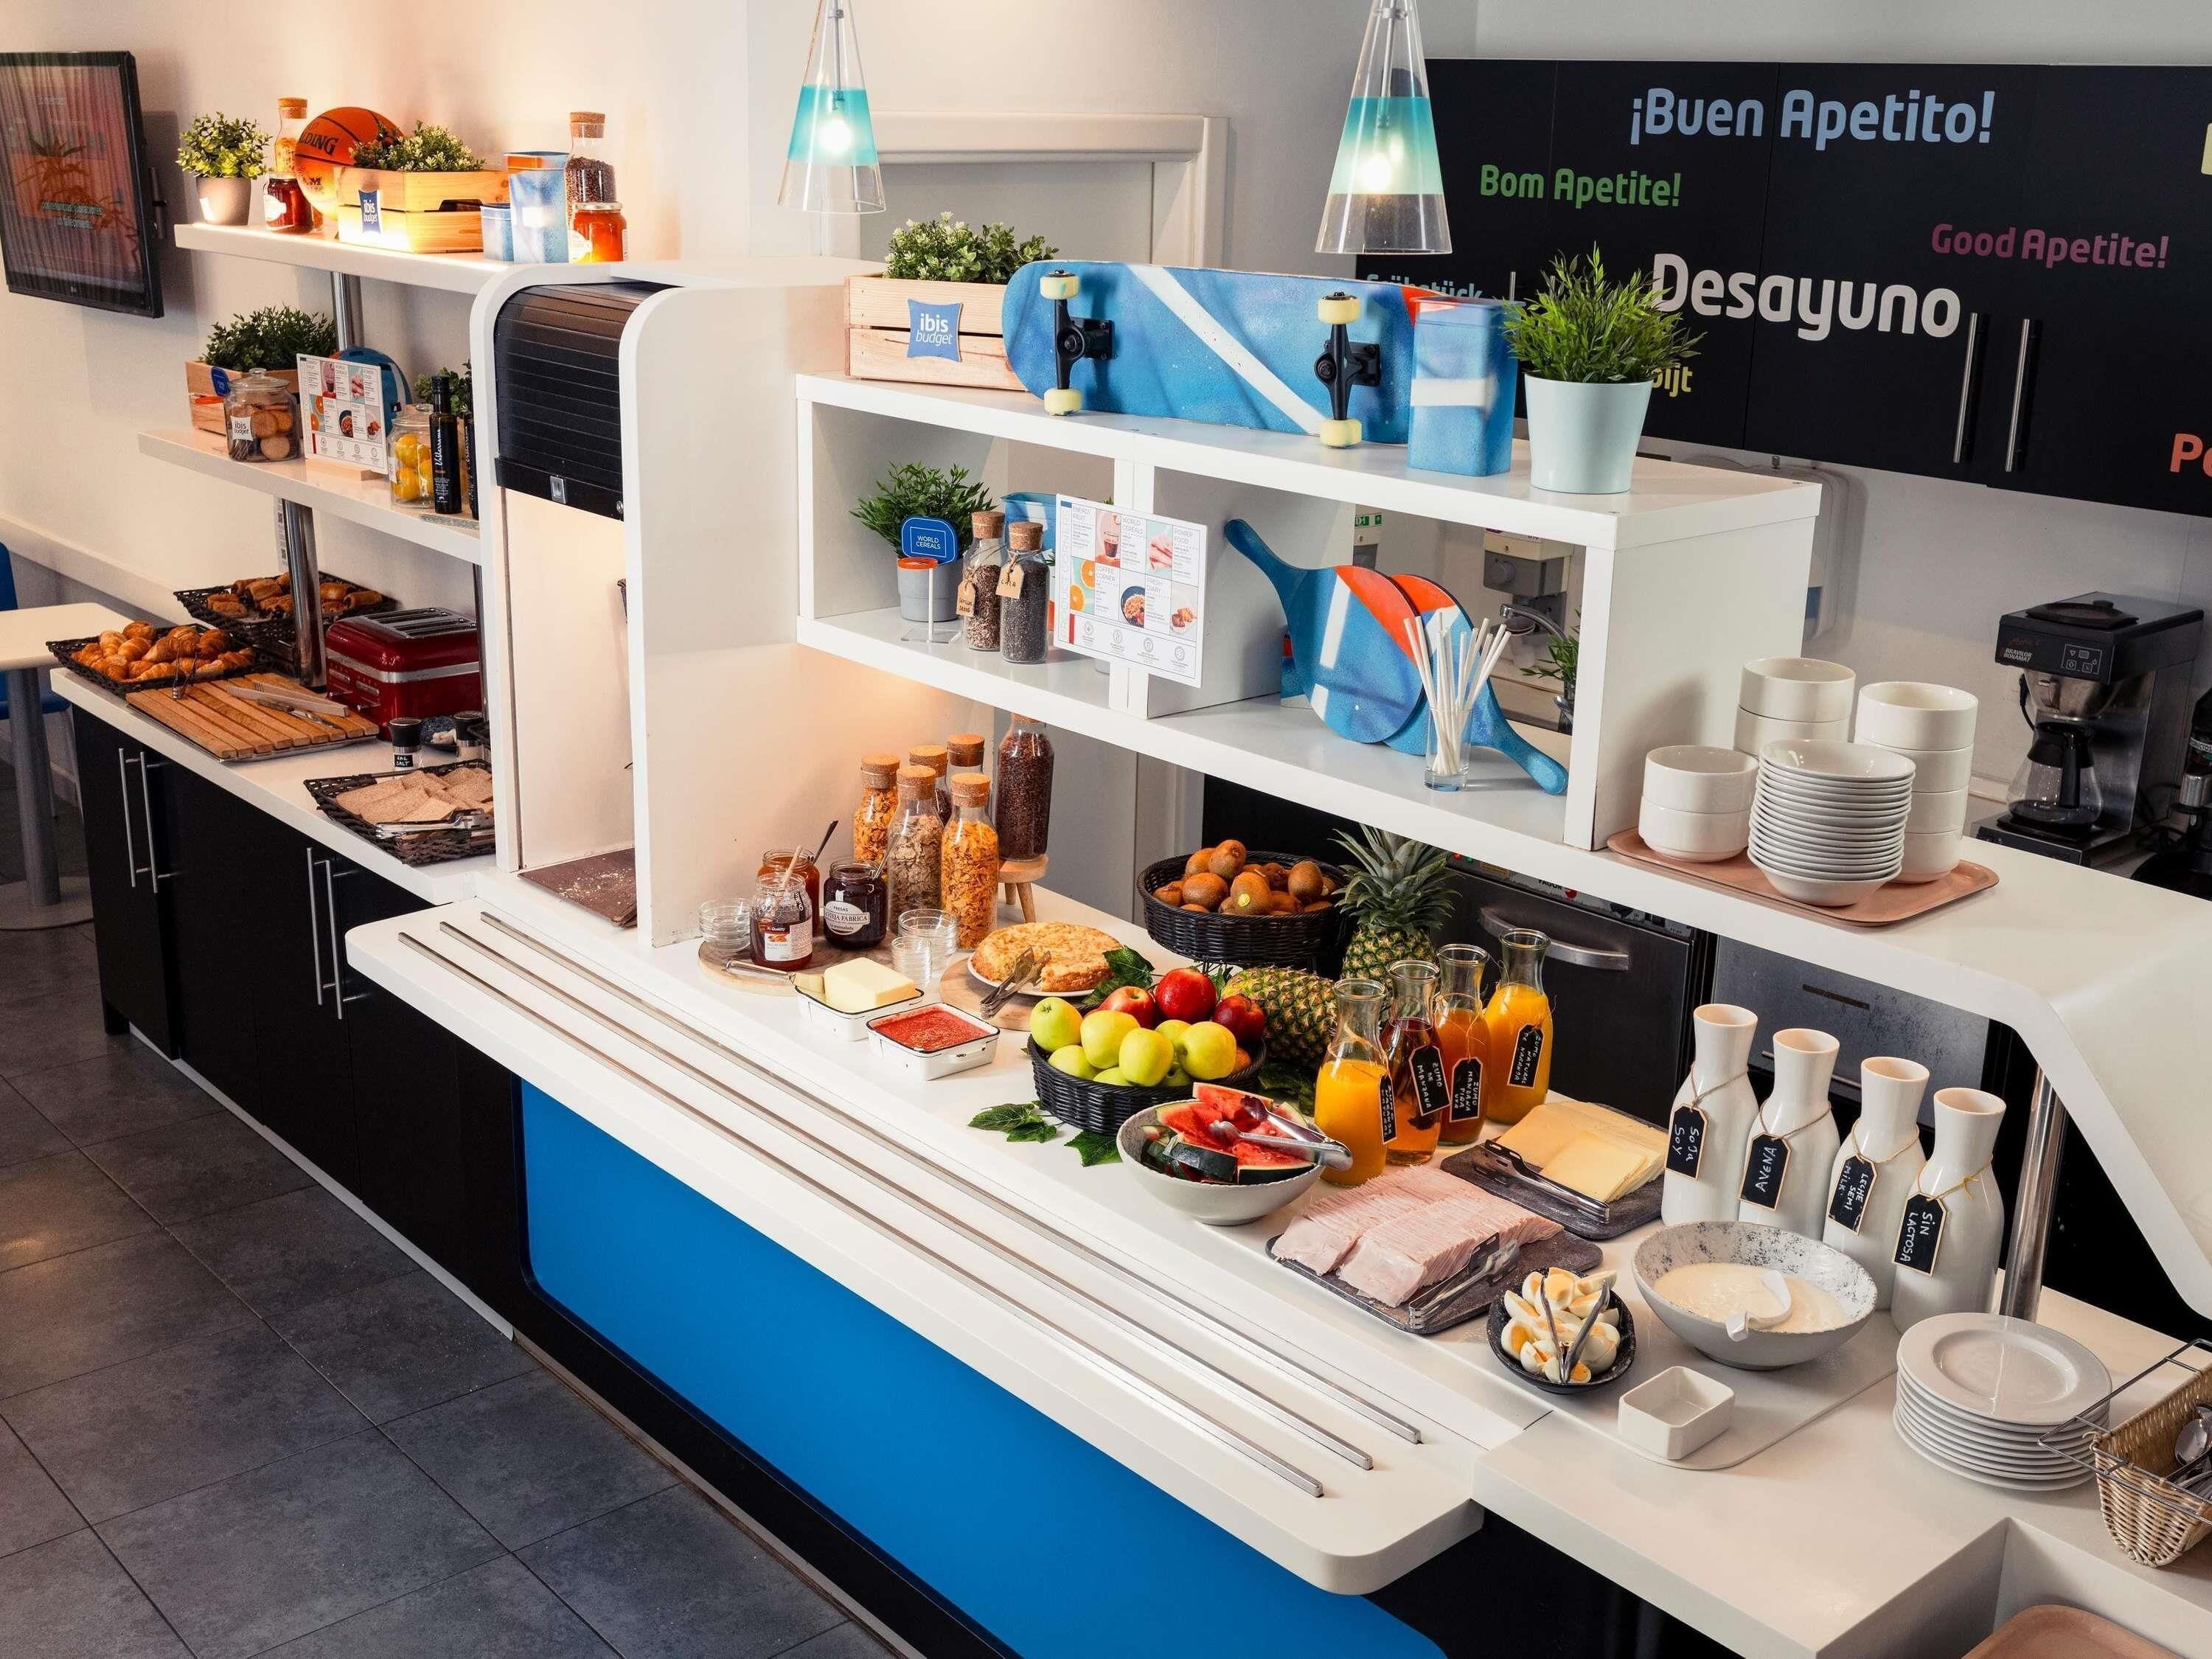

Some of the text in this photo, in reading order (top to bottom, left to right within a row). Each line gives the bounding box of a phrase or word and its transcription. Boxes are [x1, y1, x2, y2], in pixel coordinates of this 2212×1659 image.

[1630, 88, 1996, 151] ¡Buen Apetito!
[1480, 164, 1682, 209] Bom Apetite!
[364, 199, 375, 214] ibis
[1931, 223, 2170, 269] Good Apetite!
[1652, 253, 1961, 341] Desayuno
[919, 313, 950, 333] ibis
[915, 330, 953, 347] budget
[234, 420, 247, 428] ibis
[916, 540, 941, 549] CEREALS
[917, 535, 939, 543] WORLD
[1533, 1031, 1542, 1058] ZUMO
[1417, 1064, 1432, 1108] MANZANA
[1427, 1072, 1433, 1082] DE
[1433, 1062, 1443, 1088] ZUMO
[1755, 1147, 1778, 1192] AVENA
[1855, 1173, 1868, 1203] LECHE
[1899, 1211, 1919, 1262] LACTOSA
